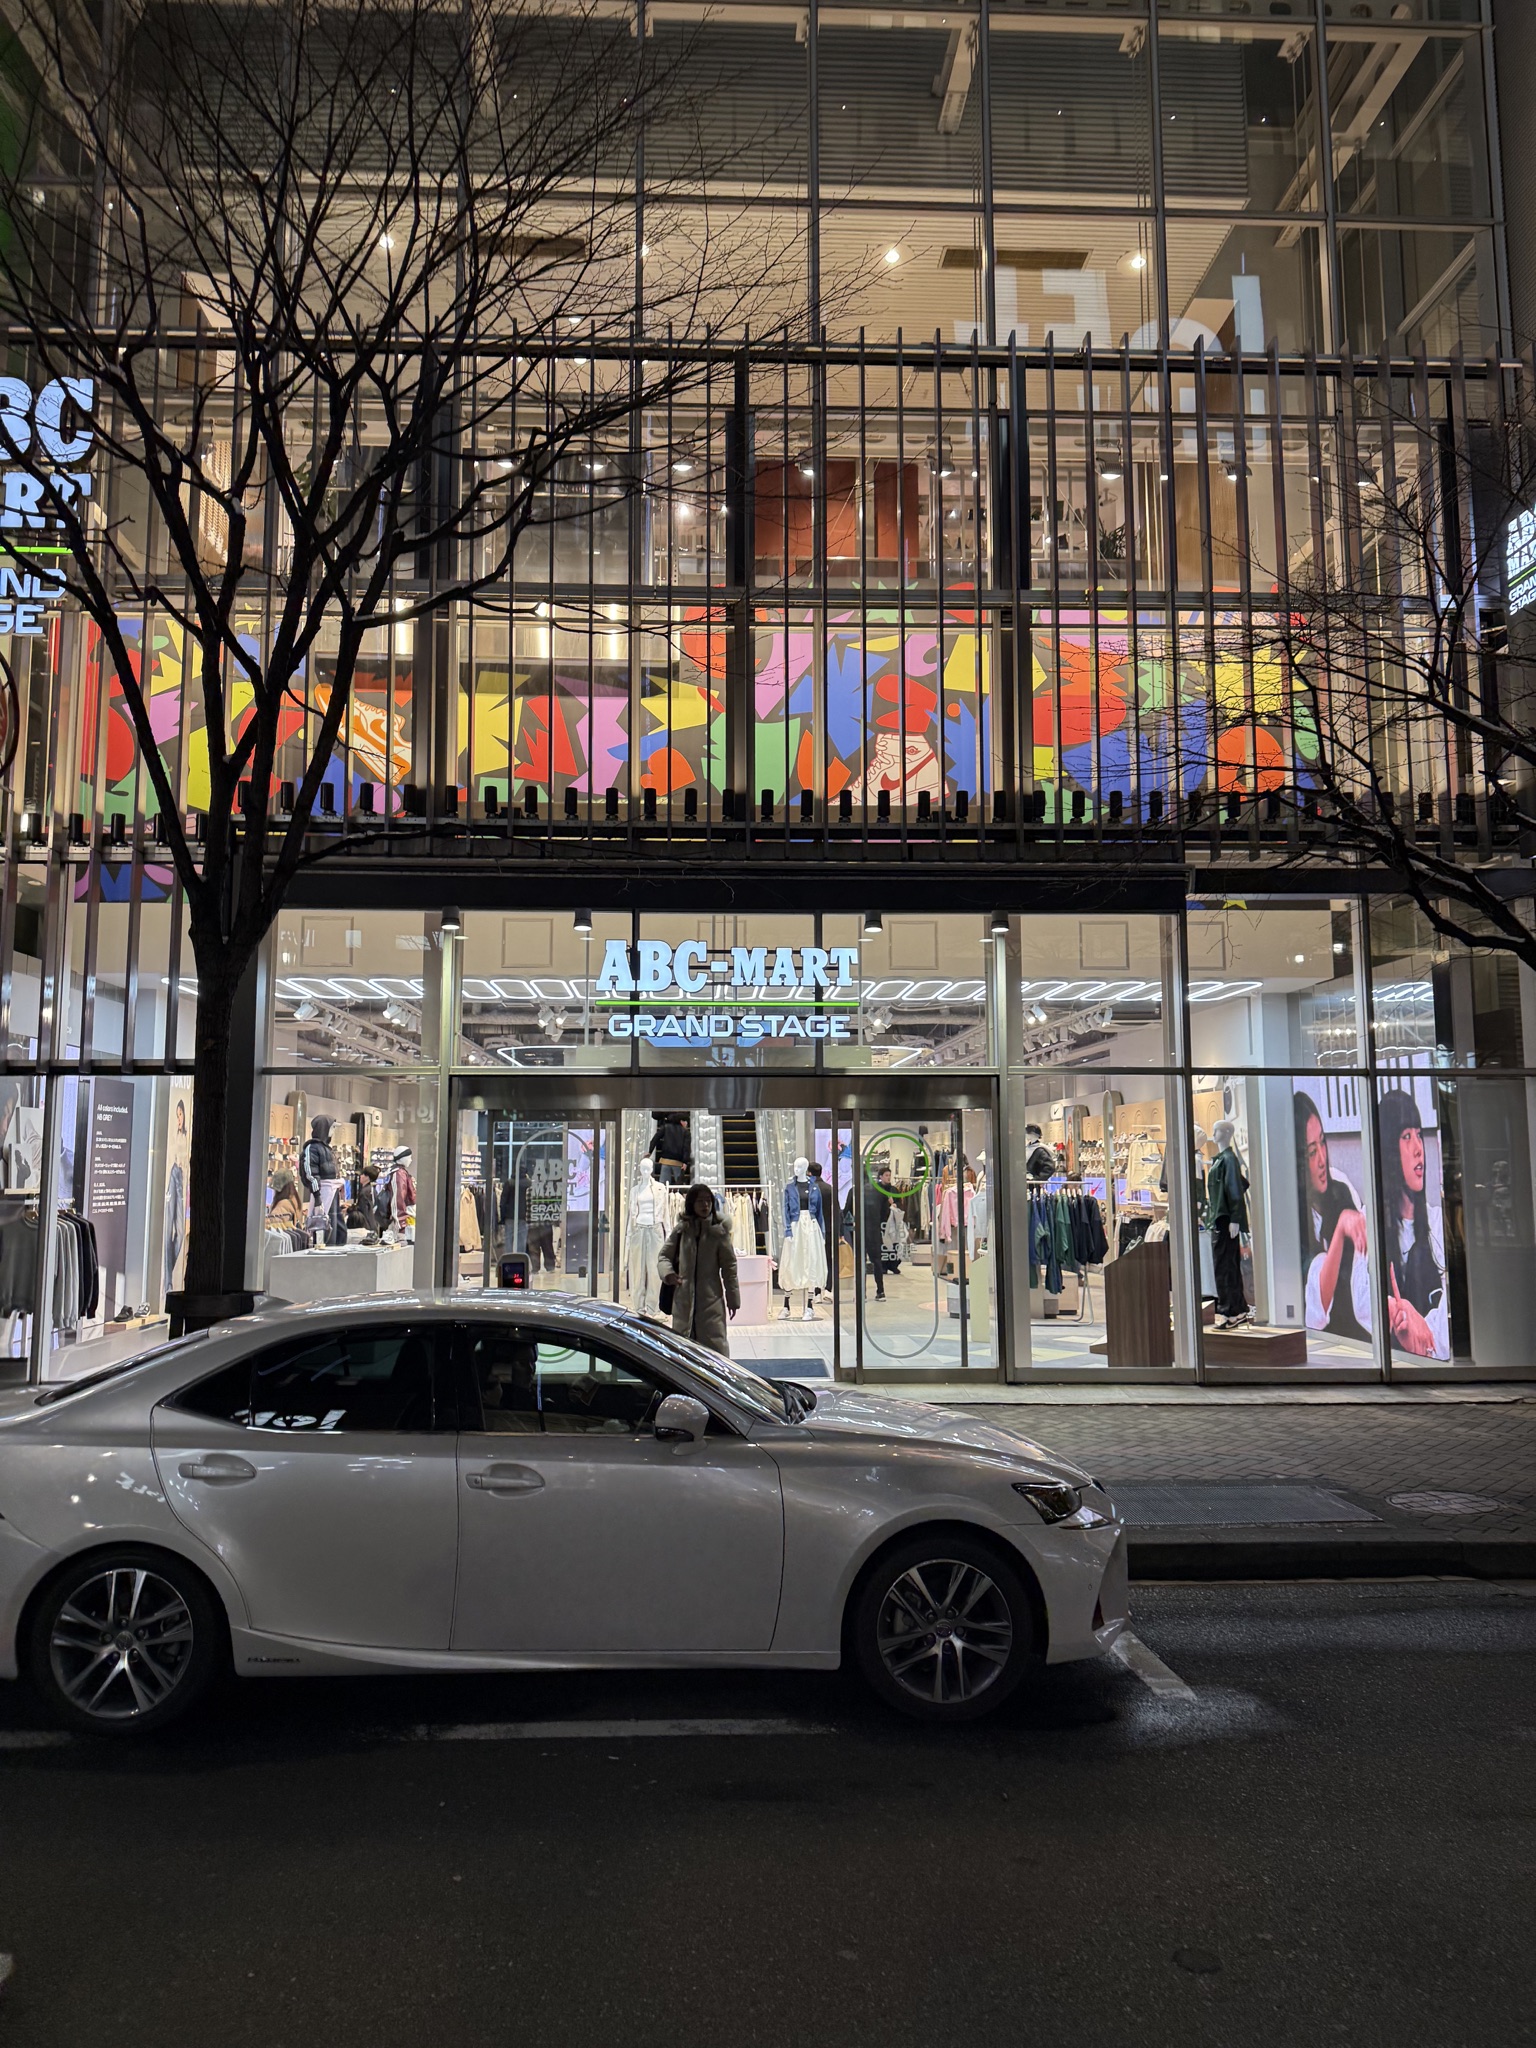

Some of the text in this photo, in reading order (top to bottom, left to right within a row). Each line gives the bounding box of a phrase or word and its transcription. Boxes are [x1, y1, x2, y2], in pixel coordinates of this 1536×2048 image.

[595, 939, 858, 993] ABC-MART
[608, 1014, 851, 1038] GRAND STAGE
[532, 1159, 577, 1181] ABC
[530, 1203, 570, 1213] GRAN
[530, 1213, 562, 1222] STAG
